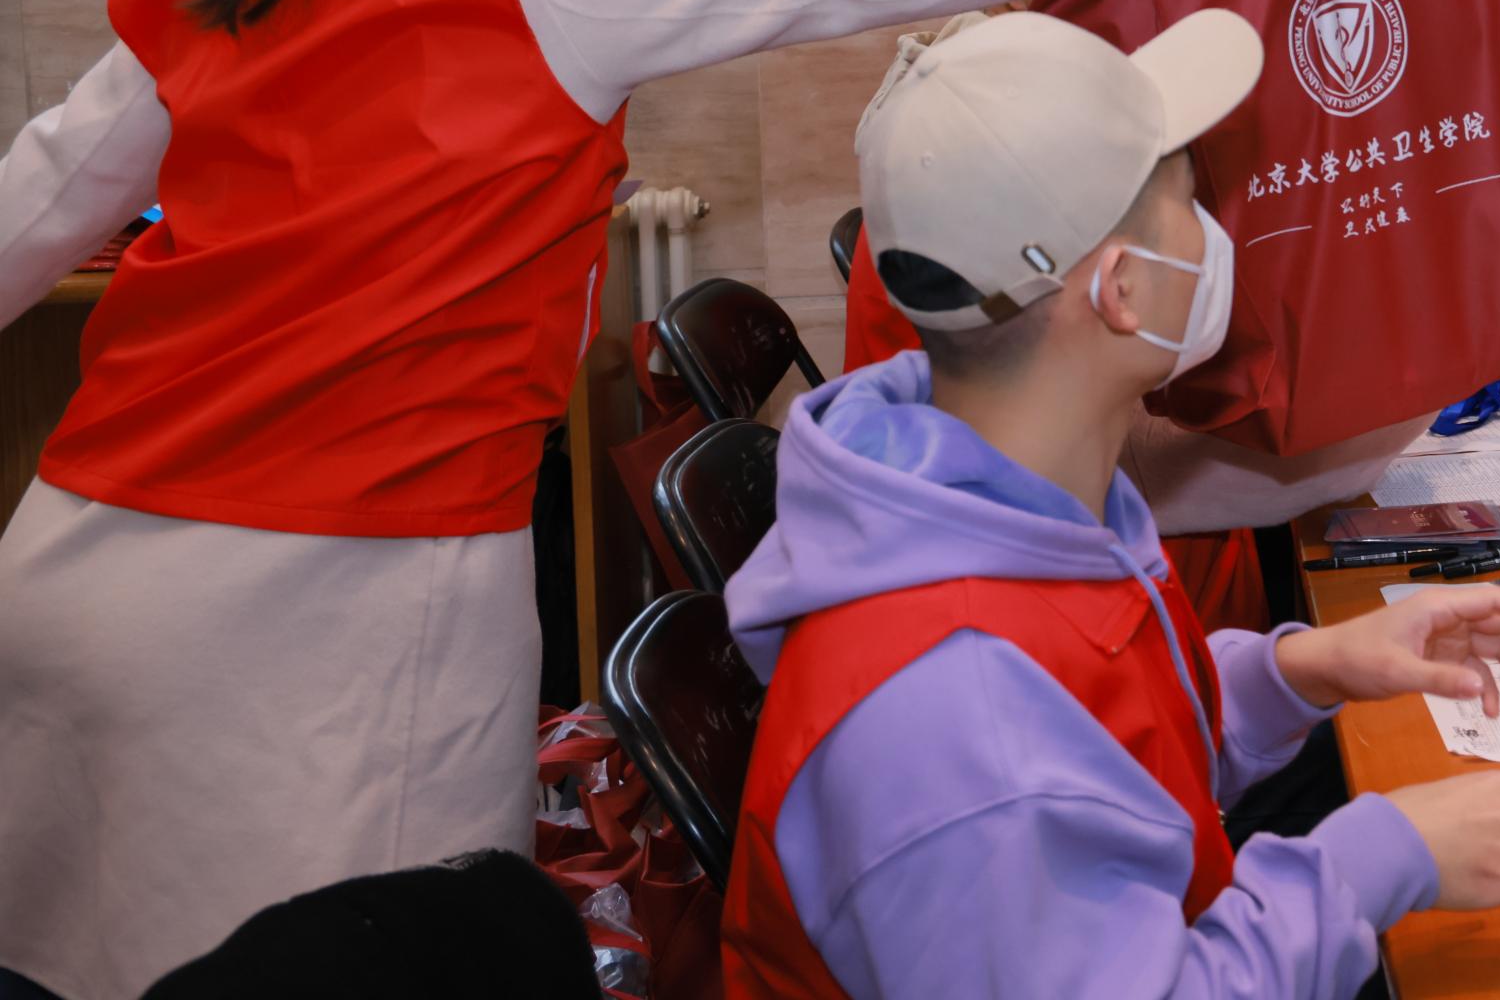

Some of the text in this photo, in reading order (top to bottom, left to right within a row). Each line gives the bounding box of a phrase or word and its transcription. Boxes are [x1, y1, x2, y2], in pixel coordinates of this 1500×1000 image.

[1371, 81, 1385, 95] OF
[1382, 46, 1402, 83] PUBLIC
[1248, 112, 1490, 202] 北京大学公共卫生学院
